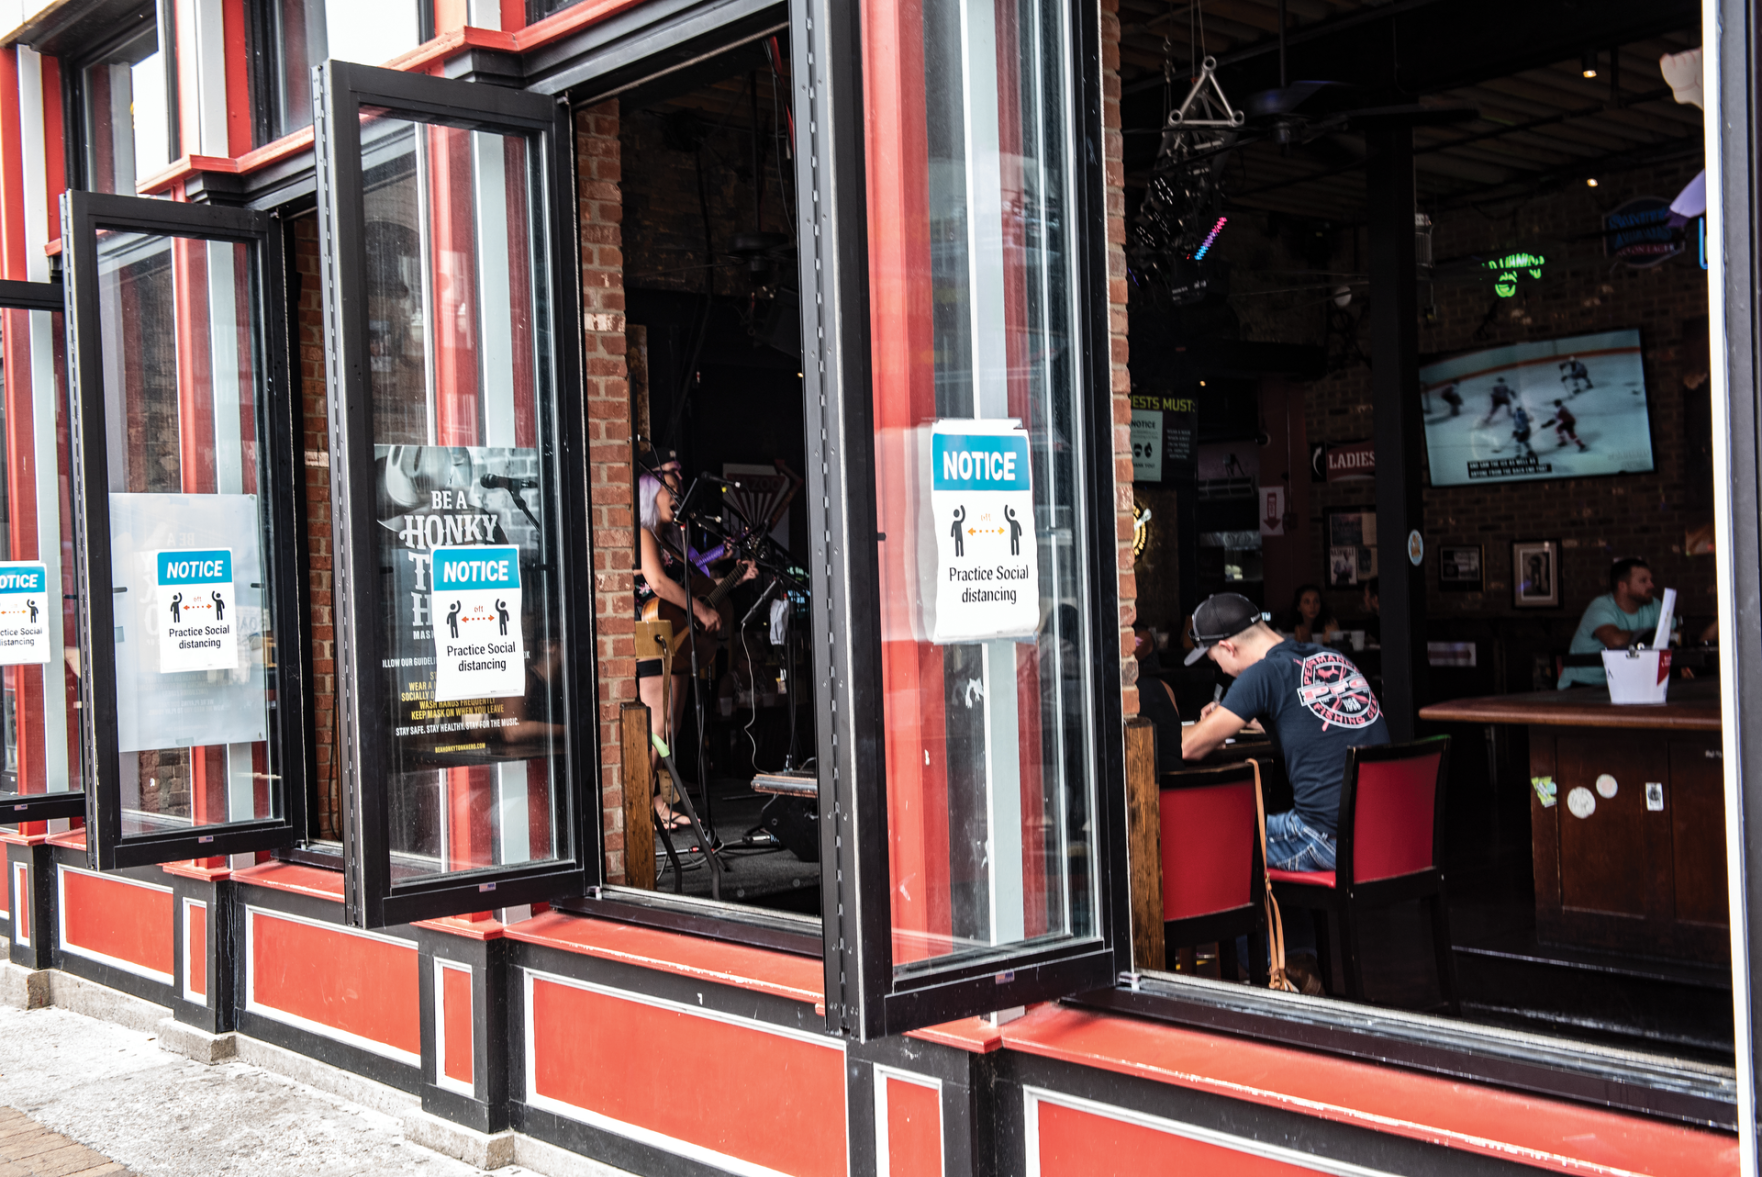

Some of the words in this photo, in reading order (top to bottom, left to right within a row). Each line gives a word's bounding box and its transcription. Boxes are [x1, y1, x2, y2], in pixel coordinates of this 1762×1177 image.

[1130, 395, 1160, 410] ESTS
[1163, 397, 1195, 412] MUST:
[942, 450, 1017, 481] NOTICE
[1328, 451, 1375, 469] LADIES
[431, 490, 452, 510] BE
[456, 490, 468, 510] A
[398, 514, 498, 550] HONKY
[166, 560, 224, 578] NOTICE
[443, 560, 509, 582] NOTICE
[949, 566, 993, 582] Practice
[996, 564, 1029, 580] Social
[961, 587, 1017, 604] distancing
[1261, 612, 1272, 622] TM
[0, 628, 18, 636] ctice
[20, 627, 42, 636] Social
[168, 627, 203, 638] Practice
[204, 624, 230, 635] Social
[0, 638, 35, 646] istancing
[178, 638, 222, 650] distancing
[446, 644, 486, 656] Practice
[487, 641, 516, 654] Social
[382, 658, 400, 668] LLOW
[400, 658, 413, 667] OUR
[414, 656, 437, 666] GUIDELI
[458, 658, 507, 672] distancing
[408, 682, 427, 692] WEAR
[428, 682, 432, 690] A
[401, 691, 430, 702] SOCIALLY
[419, 700, 438, 710] WASH
[438, 700, 460, 708] HANDS
[460, 698, 496, 707] FREQUENTLY
[411, 710, 426, 720] KEEP
[428, 709, 445, 719] MASK
[446, 708, 455, 718] ON
[456, 706, 474, 716] WHEN
[474, 705, 488, 714] YOU
[488, 704, 504, 714] LEAVE
[1313, 702, 1366, 725] FISHING
[1367, 690, 1380, 719] GEA
[396, 727, 409, 736] STAY
[410, 726, 426, 735] SAFE.
[426, 724, 440, 734] STAY
[440, 722, 466, 732] HEALTHY.
[466, 721, 480, 730] STAY
[480, 720, 490, 728] FOR
[490, 718, 500, 728] THE
[501, 718, 520, 726] MUSIC.
